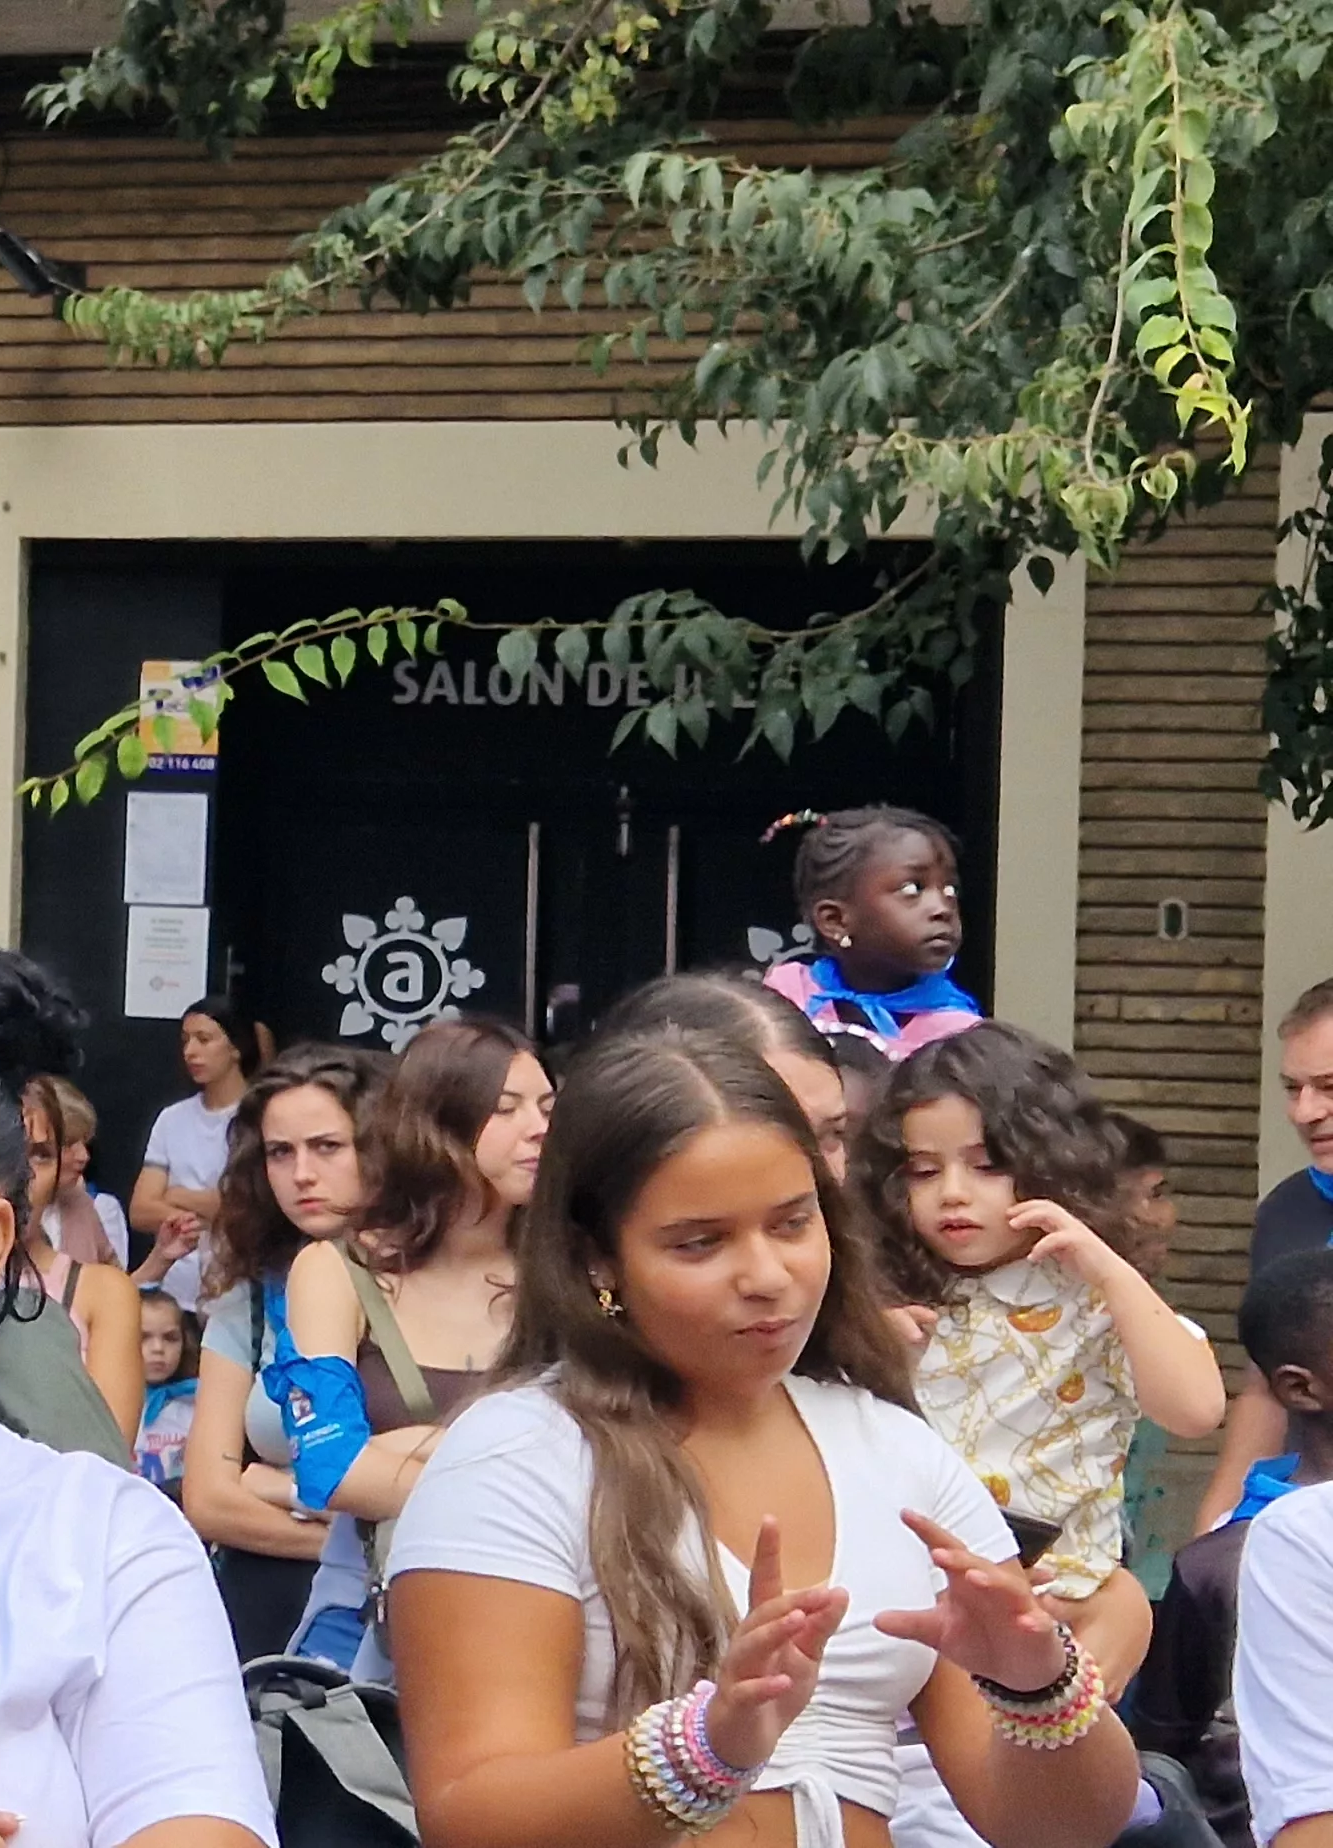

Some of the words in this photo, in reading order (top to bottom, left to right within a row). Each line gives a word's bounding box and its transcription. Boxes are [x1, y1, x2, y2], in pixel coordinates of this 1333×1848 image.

[391, 660, 565, 706] SALON
[587, 661, 651, 708] DE
[383, 951, 424, 1002] a
